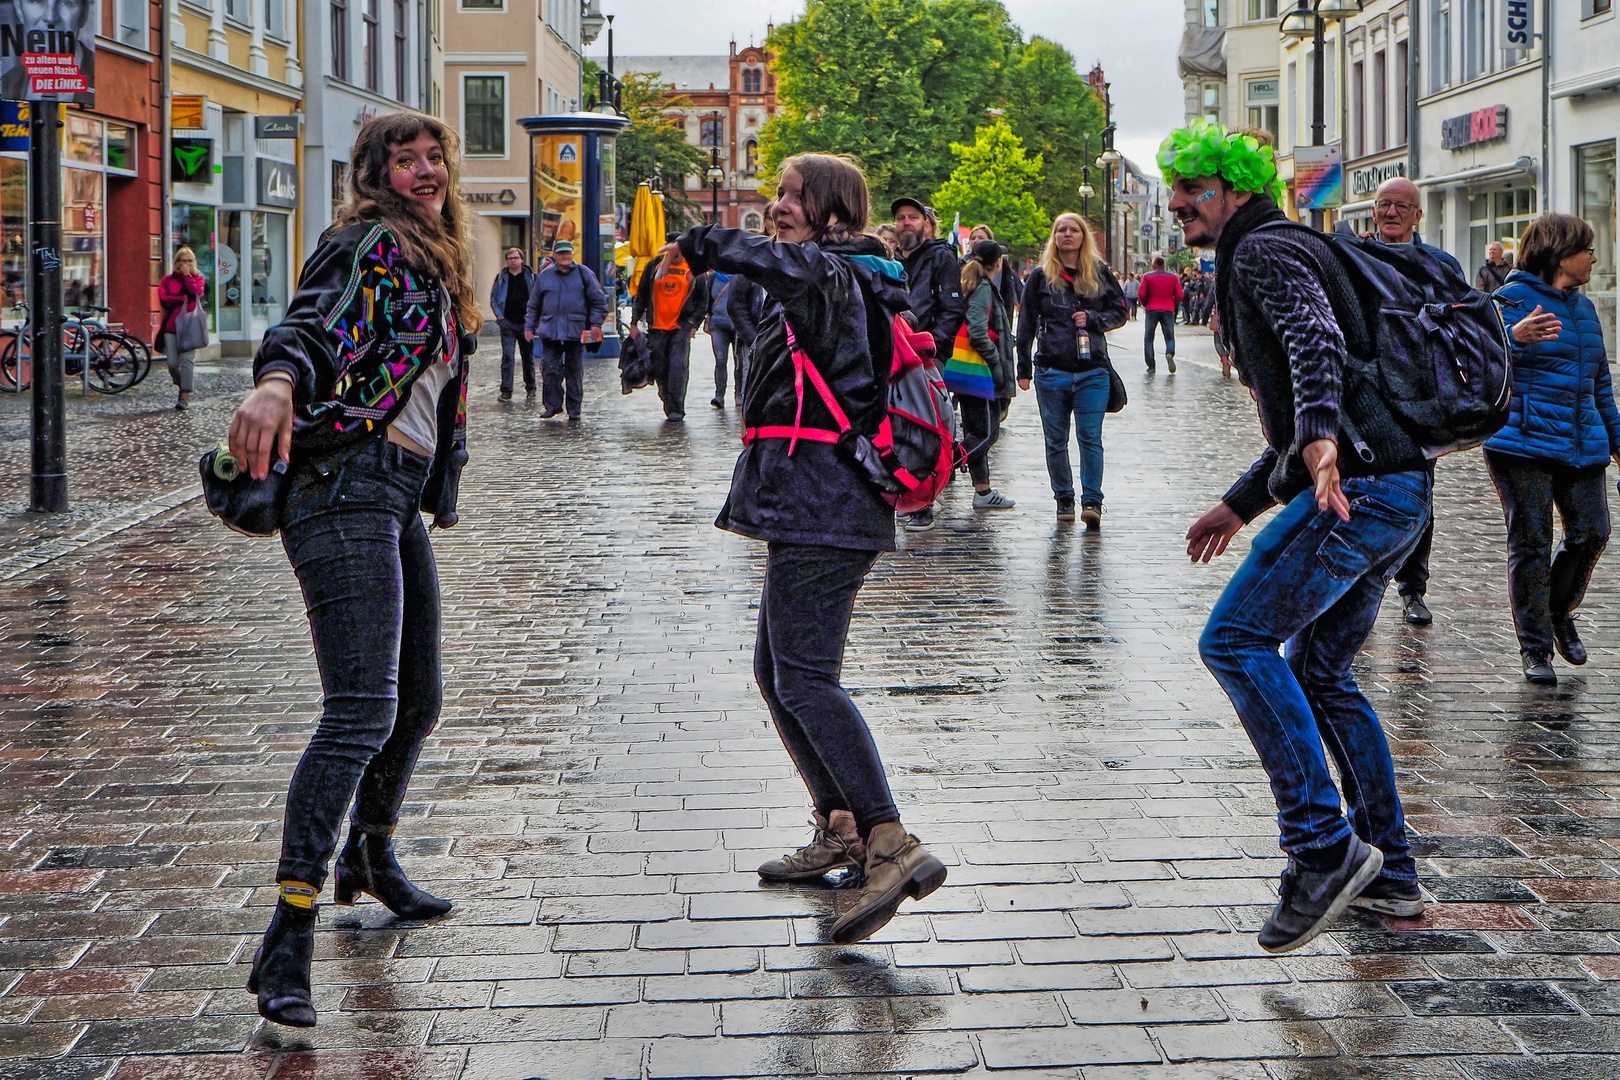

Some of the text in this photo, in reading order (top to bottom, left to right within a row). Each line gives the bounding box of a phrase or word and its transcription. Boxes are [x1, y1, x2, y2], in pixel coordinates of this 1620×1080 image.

[1, 24, 76, 57] Nein
[37, 56, 57, 64] alten
[58, 57, 72, 65] und
[28, 66, 77, 76] neuen Nazis!
[36, 79, 53, 90] DIE
[263, 122, 294, 132] Clarks
[267, 167, 296, 200] Clarks
[462, 193, 494, 203] ANK
